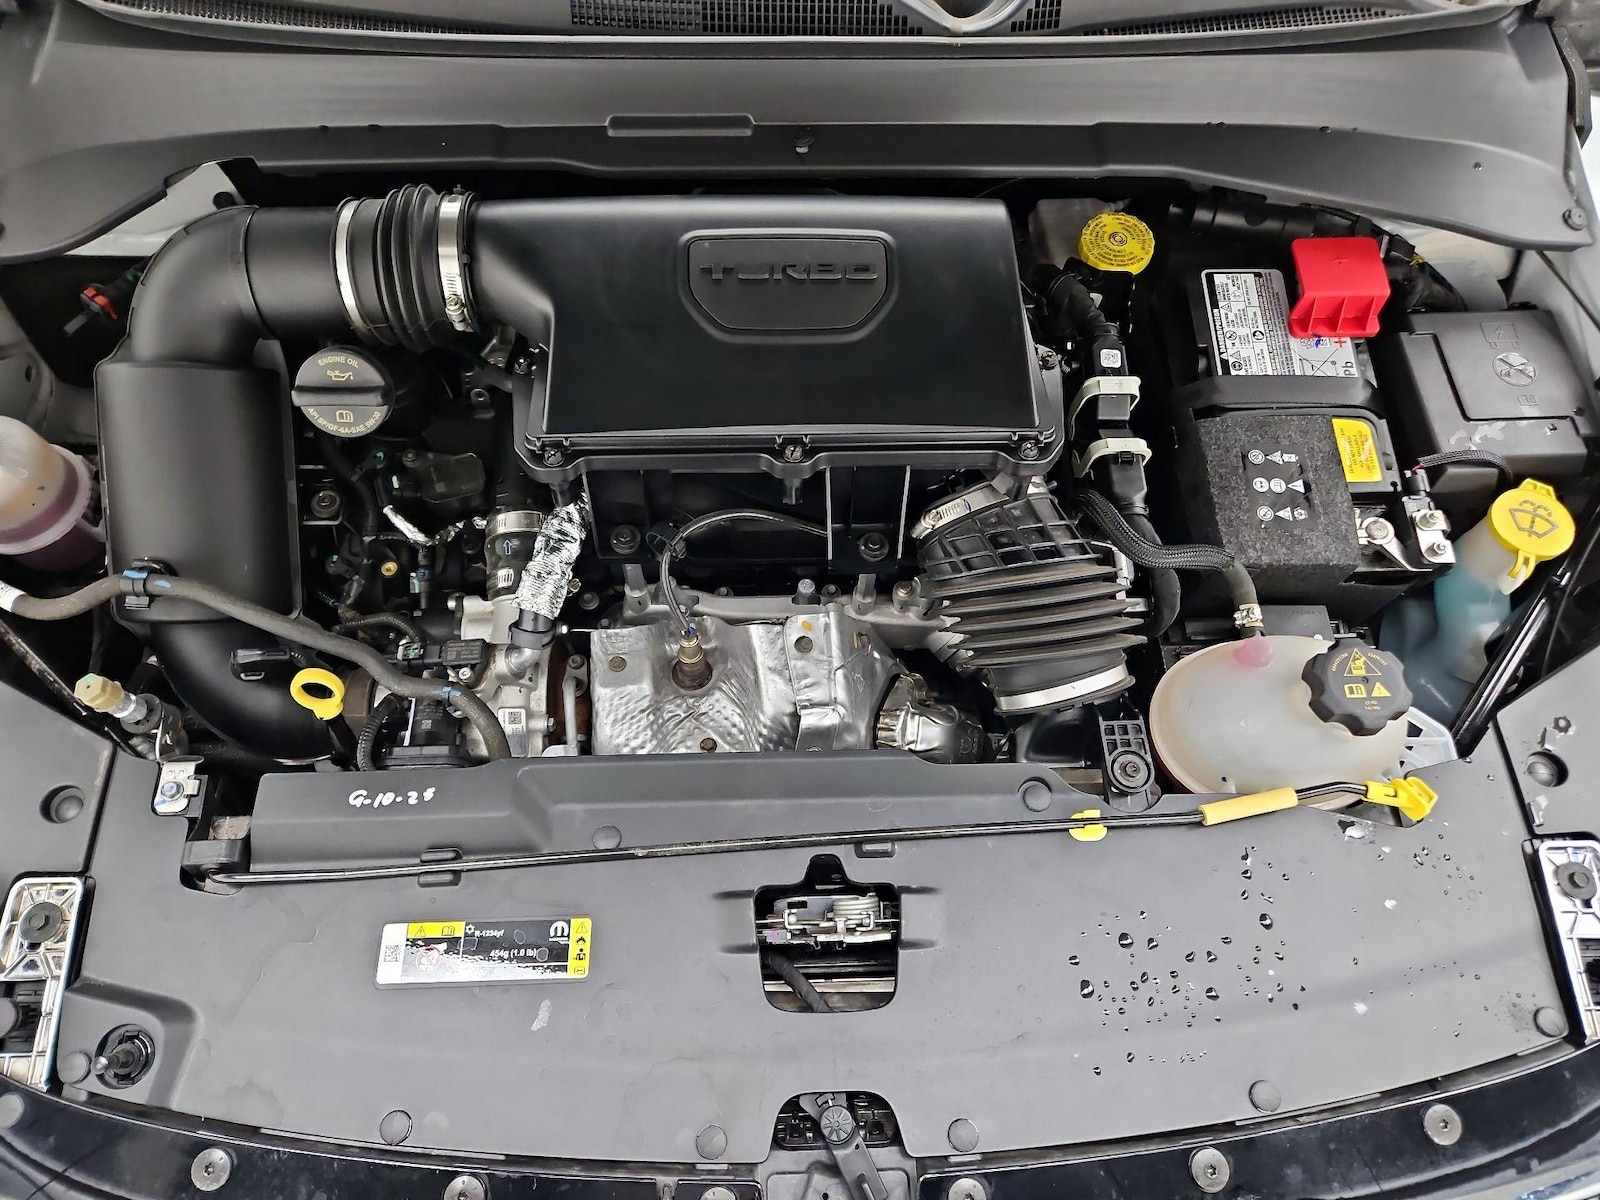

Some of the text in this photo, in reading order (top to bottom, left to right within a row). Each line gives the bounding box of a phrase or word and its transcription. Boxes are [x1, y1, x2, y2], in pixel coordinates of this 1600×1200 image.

[700, 263, 879, 280] TURBO
[317, 355, 359, 368] ENGINE OIL
[1341, 360, 1355, 376] Pb
[307, 407, 319, 419] API
[474, 929, 504, 938] R-1234yf
[489, 949, 509, 959] 454g
[526, 948, 537, 958] lb)
